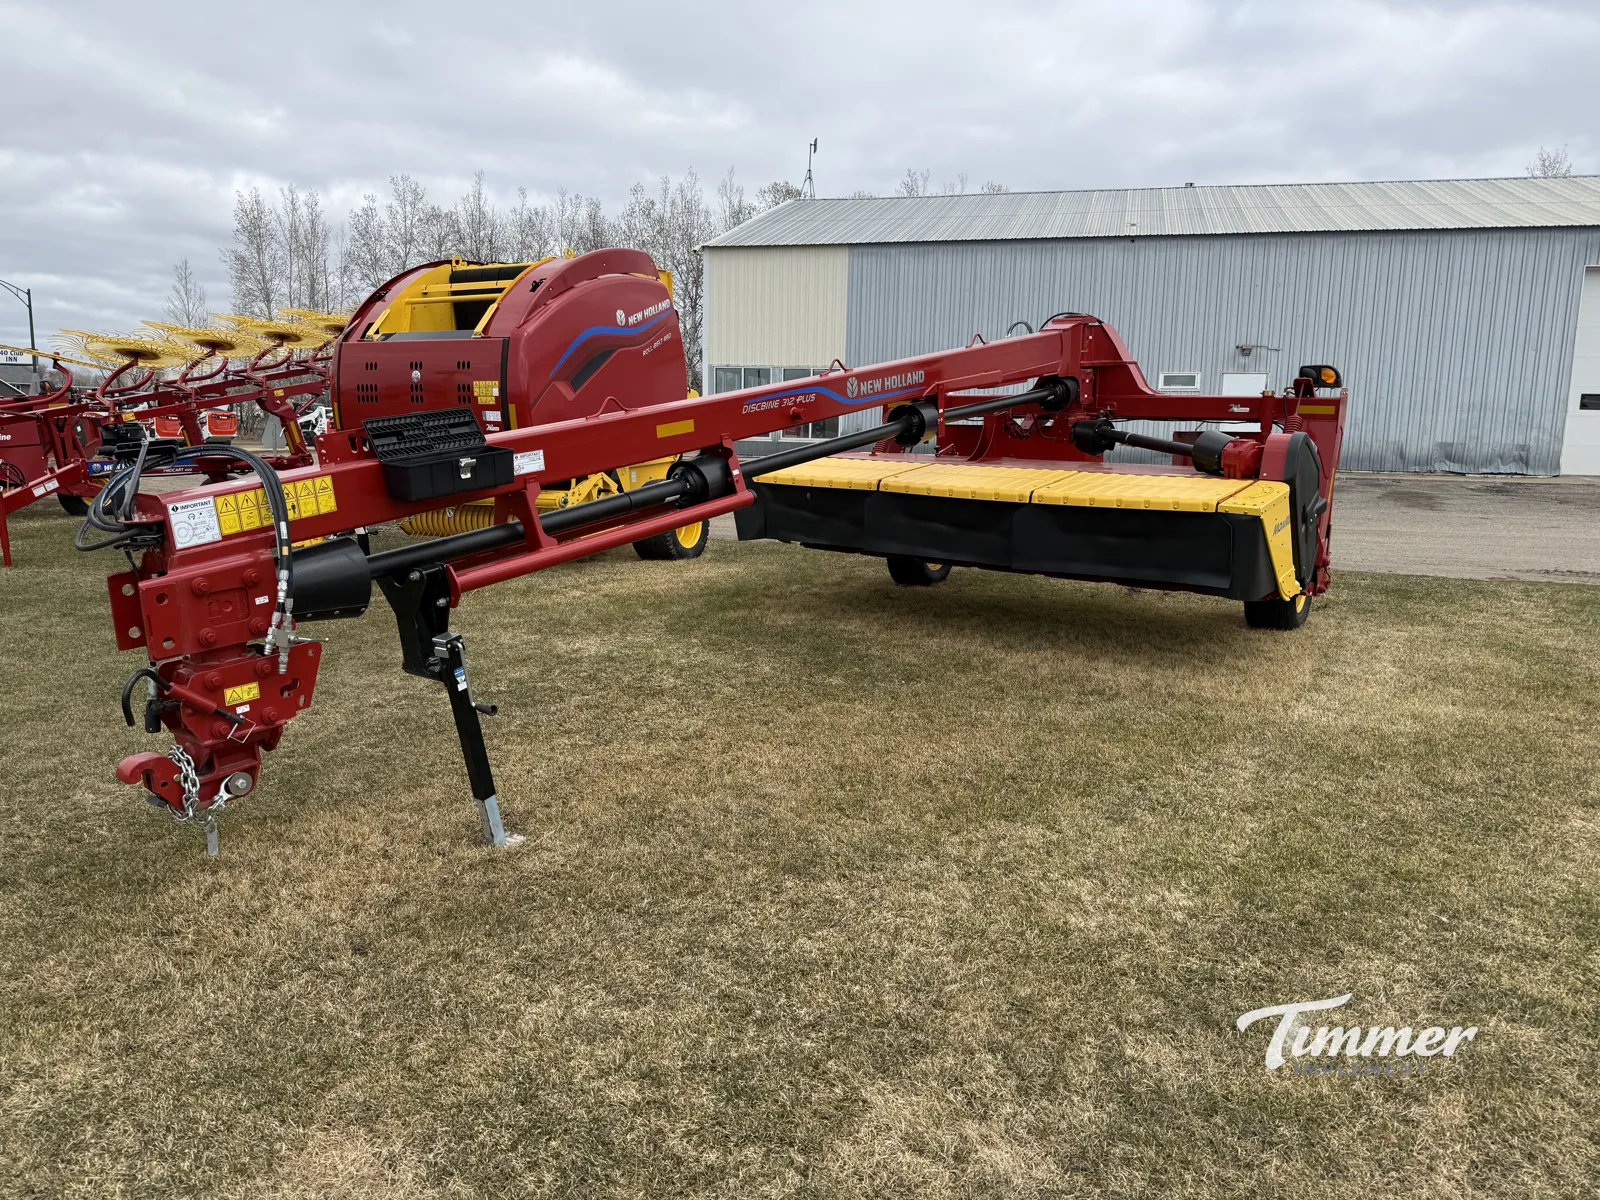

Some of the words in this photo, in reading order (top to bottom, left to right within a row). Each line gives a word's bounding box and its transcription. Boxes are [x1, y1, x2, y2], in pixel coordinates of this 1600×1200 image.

[628, 311, 643, 326] NEW
[643, 298, 671, 319] HOLLAND
[860, 380, 883, 396] NEW
[884, 370, 926, 391] HOLLAND
[742, 400, 780, 415] DISCBINE
[781, 398, 796, 408] 312
[180, 500, 212, 511] IMPORTANT
